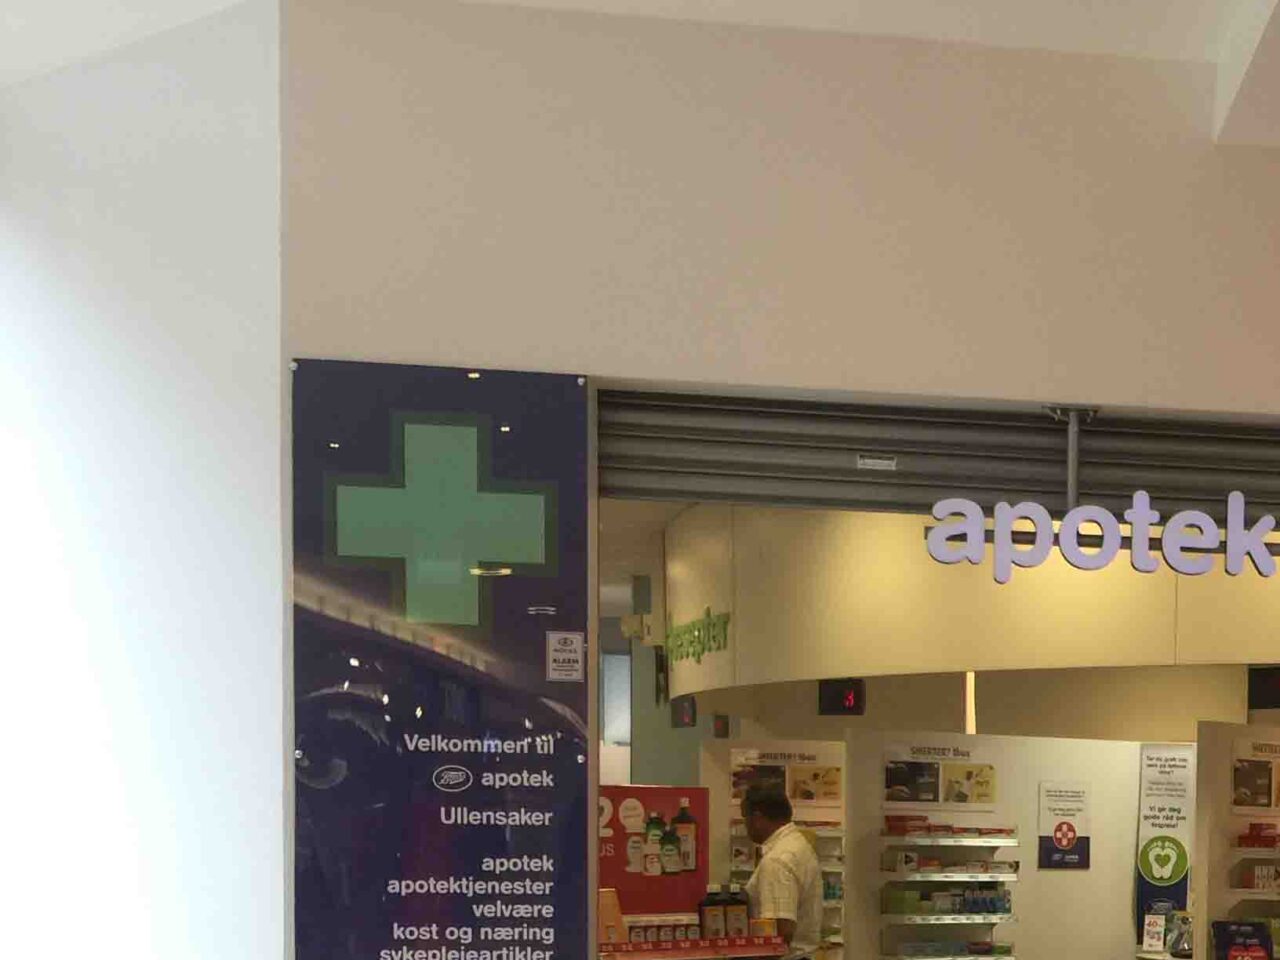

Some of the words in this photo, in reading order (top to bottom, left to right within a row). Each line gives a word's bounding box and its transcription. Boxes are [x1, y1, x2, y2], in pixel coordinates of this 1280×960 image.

[927, 490, 1277, 584] apotek
[403, 734, 529, 754] Velkommen
[535, 734, 554, 754] til
[481, 770, 554, 789] apotek
[440, 806, 553, 826] Ullensaker
[481, 854, 554, 874] apotek
[387, 876, 554, 897] apotektjenester
[472, 900, 554, 918] velvære
[393, 922, 439, 940] kost
[445, 925, 473, 944] og
[480, 923, 554, 945] næring
